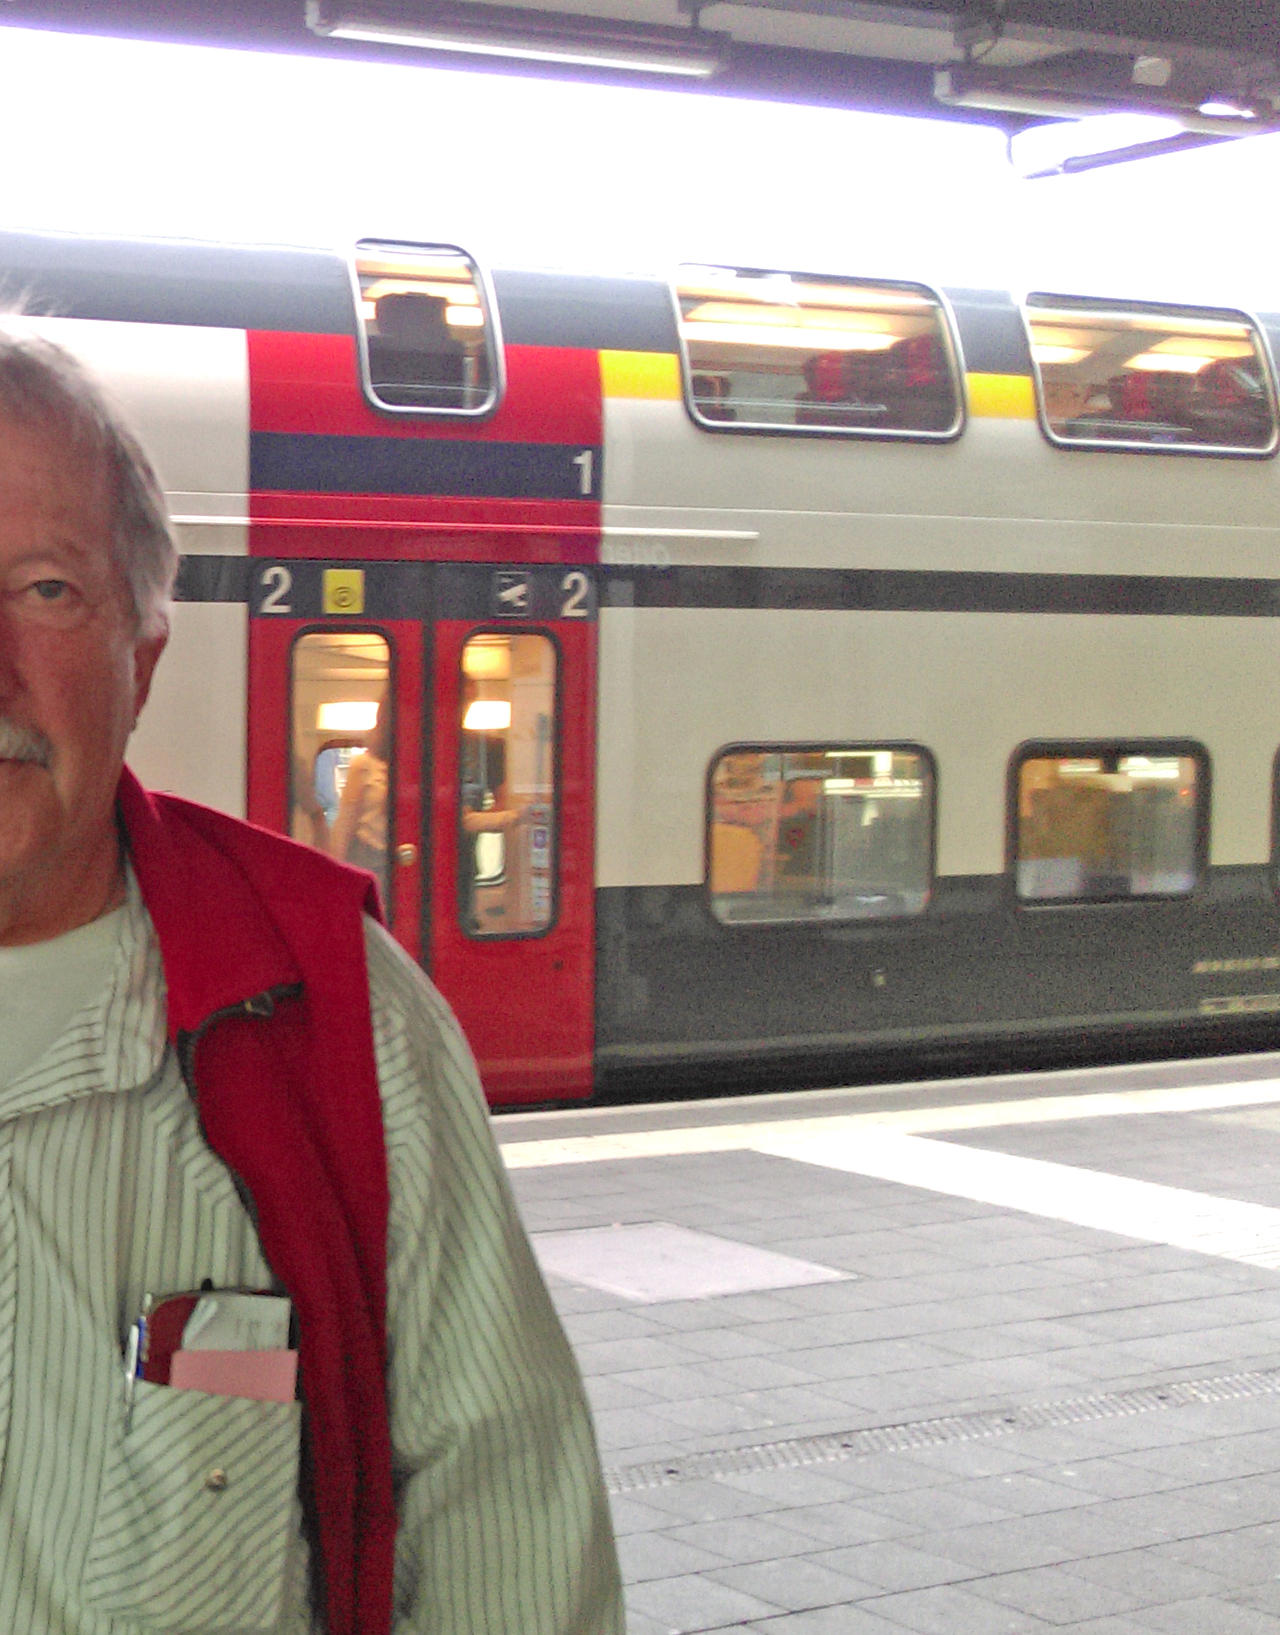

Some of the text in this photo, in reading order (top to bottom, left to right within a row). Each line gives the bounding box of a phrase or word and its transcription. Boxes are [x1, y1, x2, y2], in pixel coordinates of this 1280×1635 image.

[573, 450, 593, 494] 1
[260, 566, 292, 614] 2
[560, 572, 589, 617] 2
